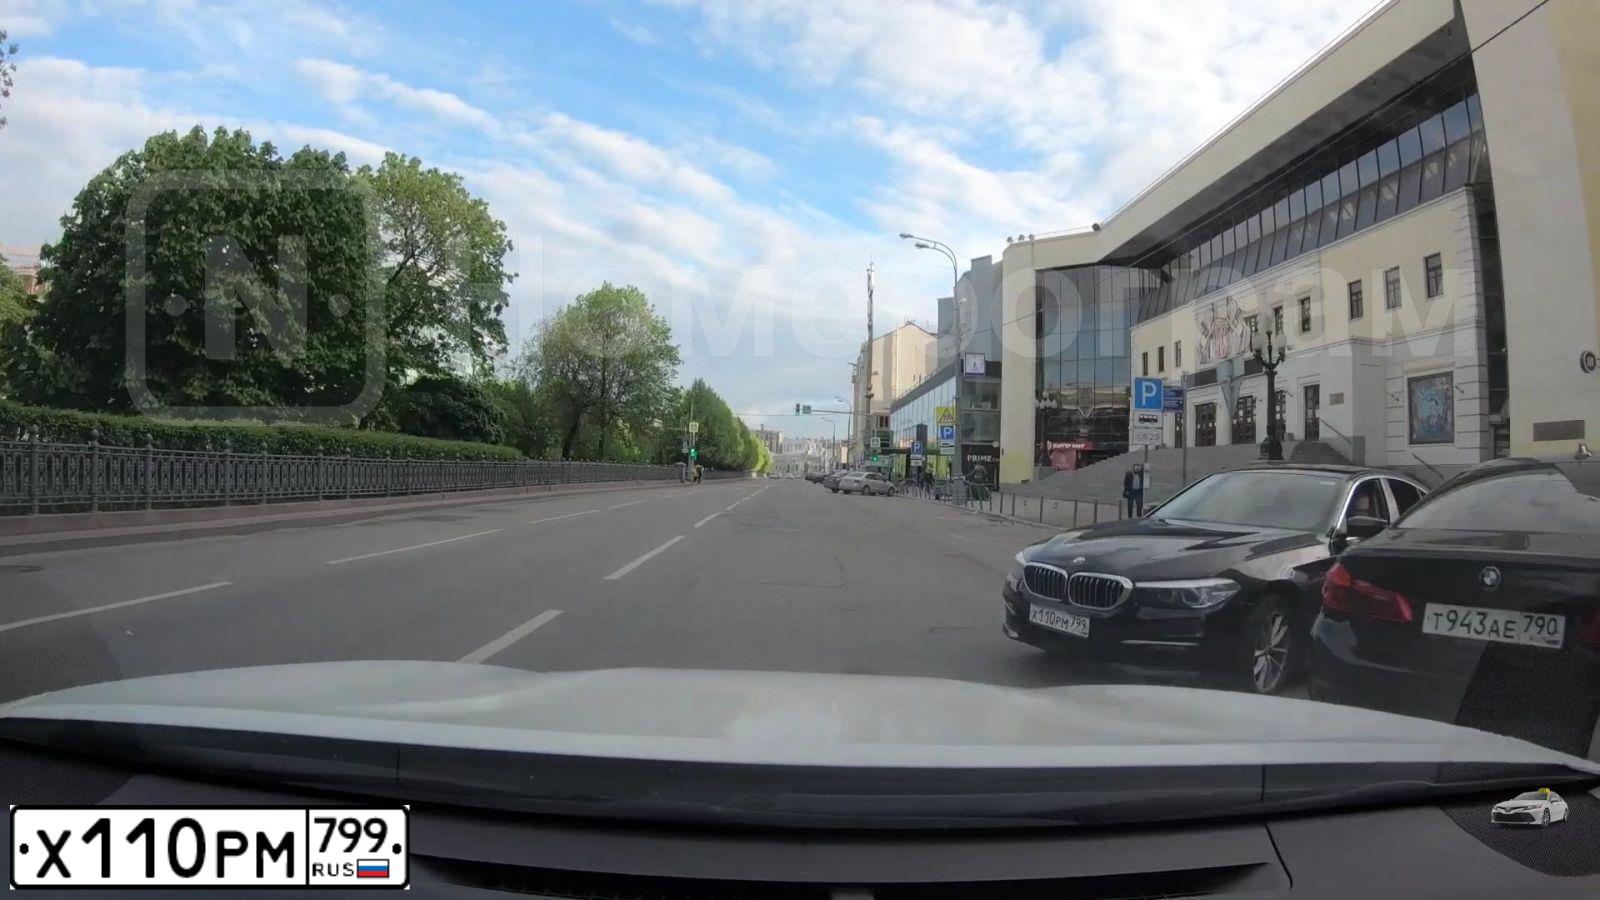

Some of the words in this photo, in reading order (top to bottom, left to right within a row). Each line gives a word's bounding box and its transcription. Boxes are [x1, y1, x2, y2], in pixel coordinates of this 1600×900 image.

[1142, 381, 1157, 405] P
[967, 454, 992, 462] PRIME
[1433, 610, 1516, 638] Т943АЕ
[1523, 615, 1557, 636] 790
